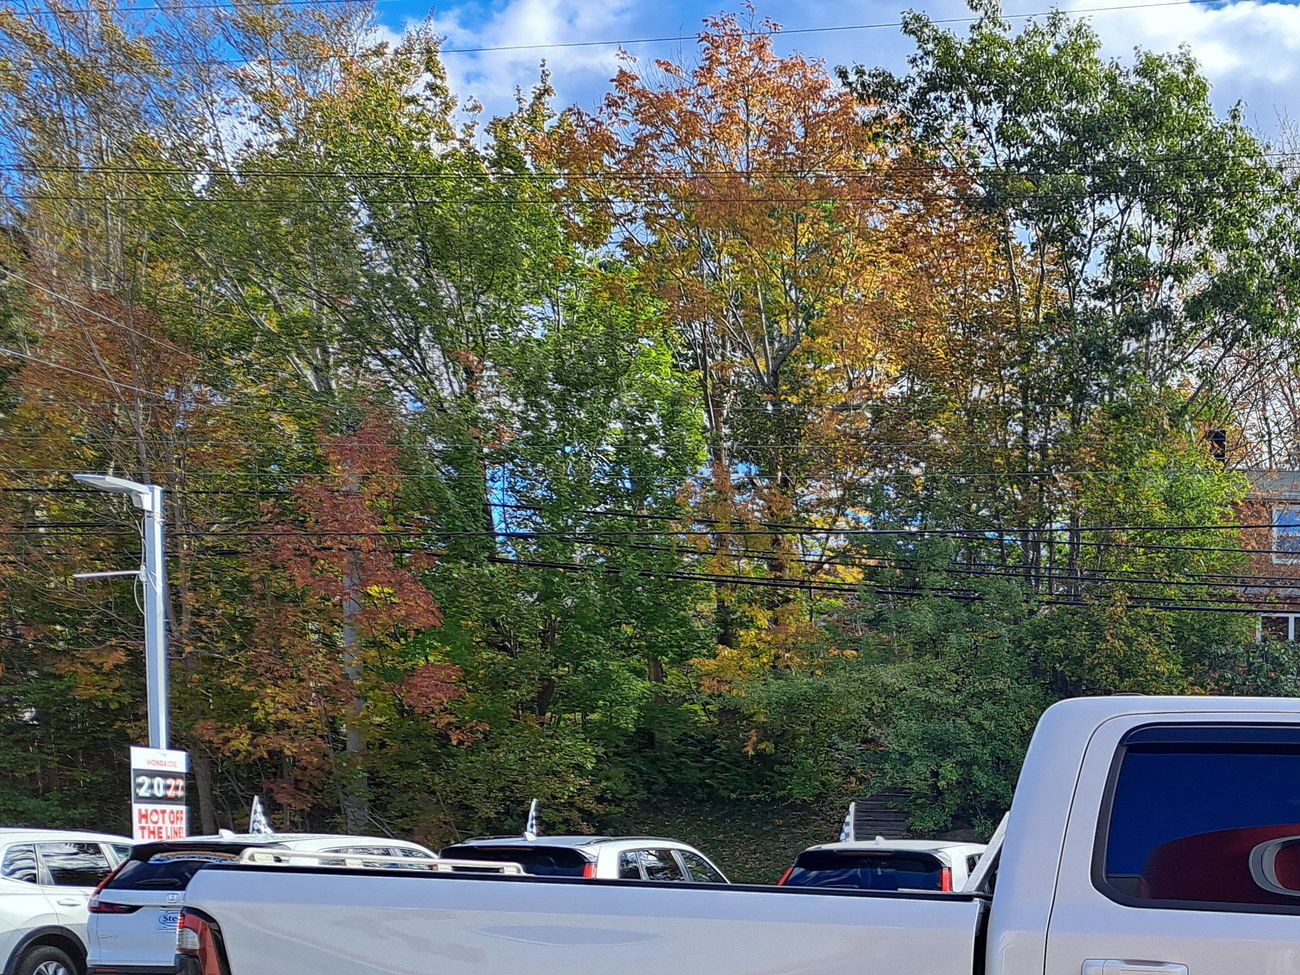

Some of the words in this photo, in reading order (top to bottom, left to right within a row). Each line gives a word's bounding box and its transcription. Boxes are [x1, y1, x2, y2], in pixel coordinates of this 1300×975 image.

[138, 808, 166, 825] HOT
[168, 809, 183, 825] OFF
[138, 826, 163, 839] THE
